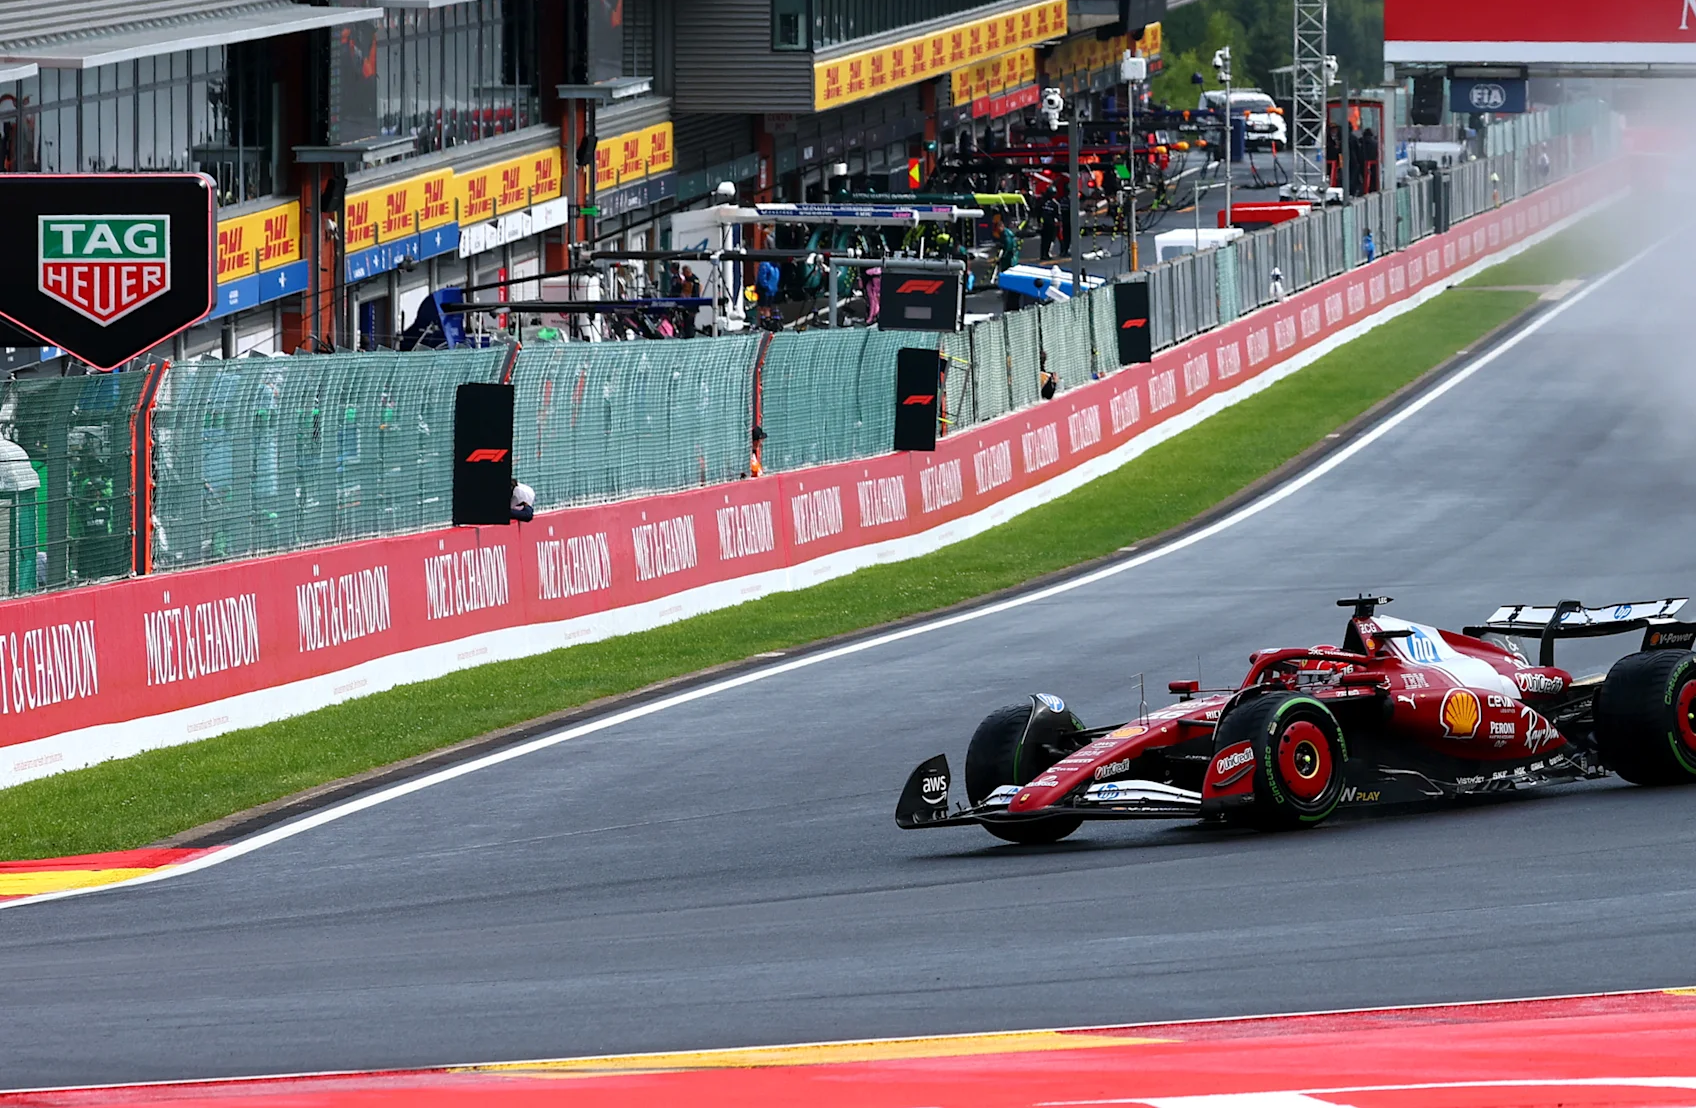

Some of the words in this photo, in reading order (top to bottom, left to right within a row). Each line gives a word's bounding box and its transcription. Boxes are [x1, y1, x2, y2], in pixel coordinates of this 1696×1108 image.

[1472, 88, 1502, 105] FIA
[498, 166, 524, 207] DHL
[532, 157, 557, 197] DHL
[420, 179, 449, 222] DHL
[464, 175, 491, 218] DHL
[346, 200, 374, 244] DHL
[383, 190, 411, 234] DHL
[50, 223, 158, 255] TAG
[262, 214, 293, 263] DHL
[47, 266, 161, 317] HEUER
[896, 279, 944, 294] F1
[1121, 318, 1147, 329] F1
[903, 394, 935, 405] F1
[464, 448, 508, 463] F1
[536, 526, 560, 600] MOËT
[567, 532, 612, 595] CHANDON
[424, 539, 453, 621] MOËT
[453, 552, 463, 616] &
[461, 545, 509, 612] CHANDON
[296, 564, 330, 652] MOËT
[330, 577, 339, 646] &
[338, 565, 391, 642] CHANDON
[1378, 596, 1388, 604] LEC
[1614, 604, 1632, 620] hp
[144, 590, 184, 686] MOËT
[183, 605, 197, 680] &
[195, 593, 260, 676] CHANDON
[1410, 633, 1439, 662] hp
[1660, 631, 1694, 645] V-Power
[10, 632, 25, 714] &
[23, 620, 98, 710] CHANDON
[1401, 673, 1430, 690] IBM
[1527, 673, 1564, 693] UniCredit
[1664, 661, 1689, 705] Cinturato
[1037, 693, 1064, 711] hp
[1490, 721, 1515, 735] PERONI
[1101, 758, 1130, 779] UniCredit
[1223, 747, 1254, 772] UniCredit
[922, 775, 947, 793] aws
[1264, 746, 1285, 804] Cinturato
[1492, 770, 1508, 780] SKF
[1098, 784, 1119, 800] hp
[1356, 791, 1381, 802] PLAY
